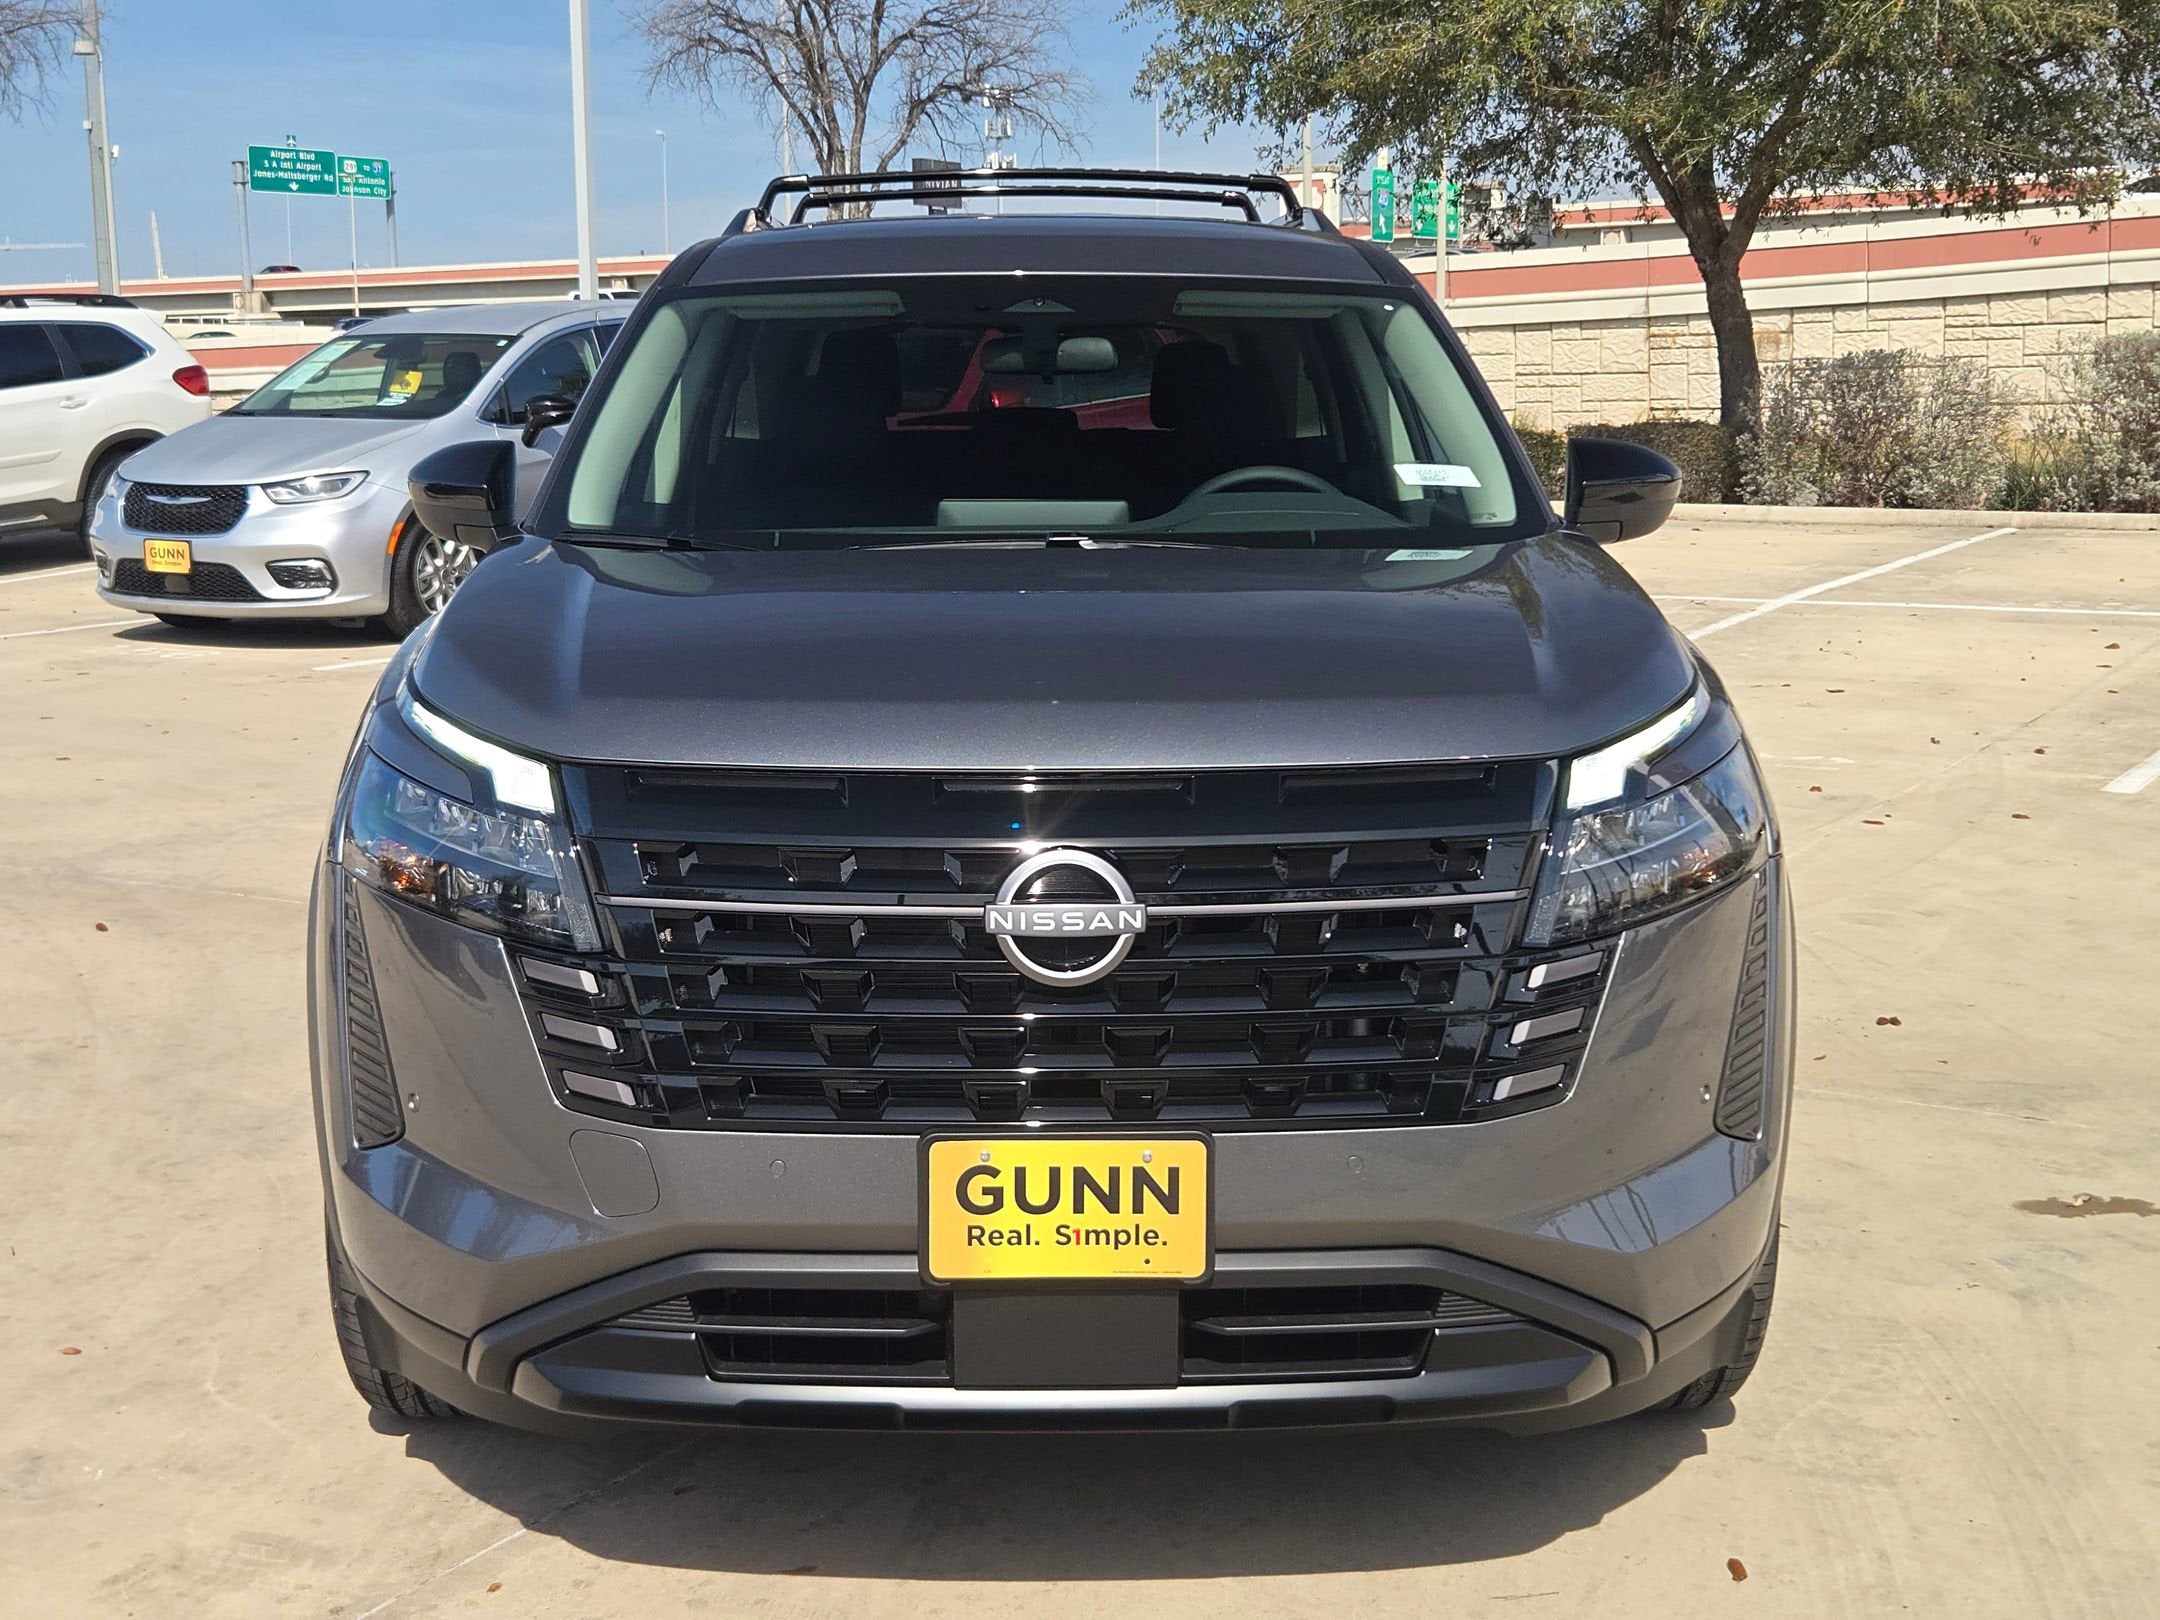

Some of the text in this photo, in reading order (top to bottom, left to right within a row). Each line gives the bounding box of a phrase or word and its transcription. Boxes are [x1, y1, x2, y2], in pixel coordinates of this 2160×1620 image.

[270, 150, 315, 160] Airport Blvd
[264, 160, 269, 168] S
[272, 160, 277, 168] A
[296, 162, 322, 172] Airport
[253, 169, 334, 182] Jones-Maltsberger Rd
[358, 177, 386, 185] Antonio
[373, 187, 387, 197] City
[150, 546, 185, 560] GUNN
[989, 910, 1142, 931] NISSAN
[955, 1164, 1180, 1215] GUNN
[967, 1224, 1040, 1246] Real.
